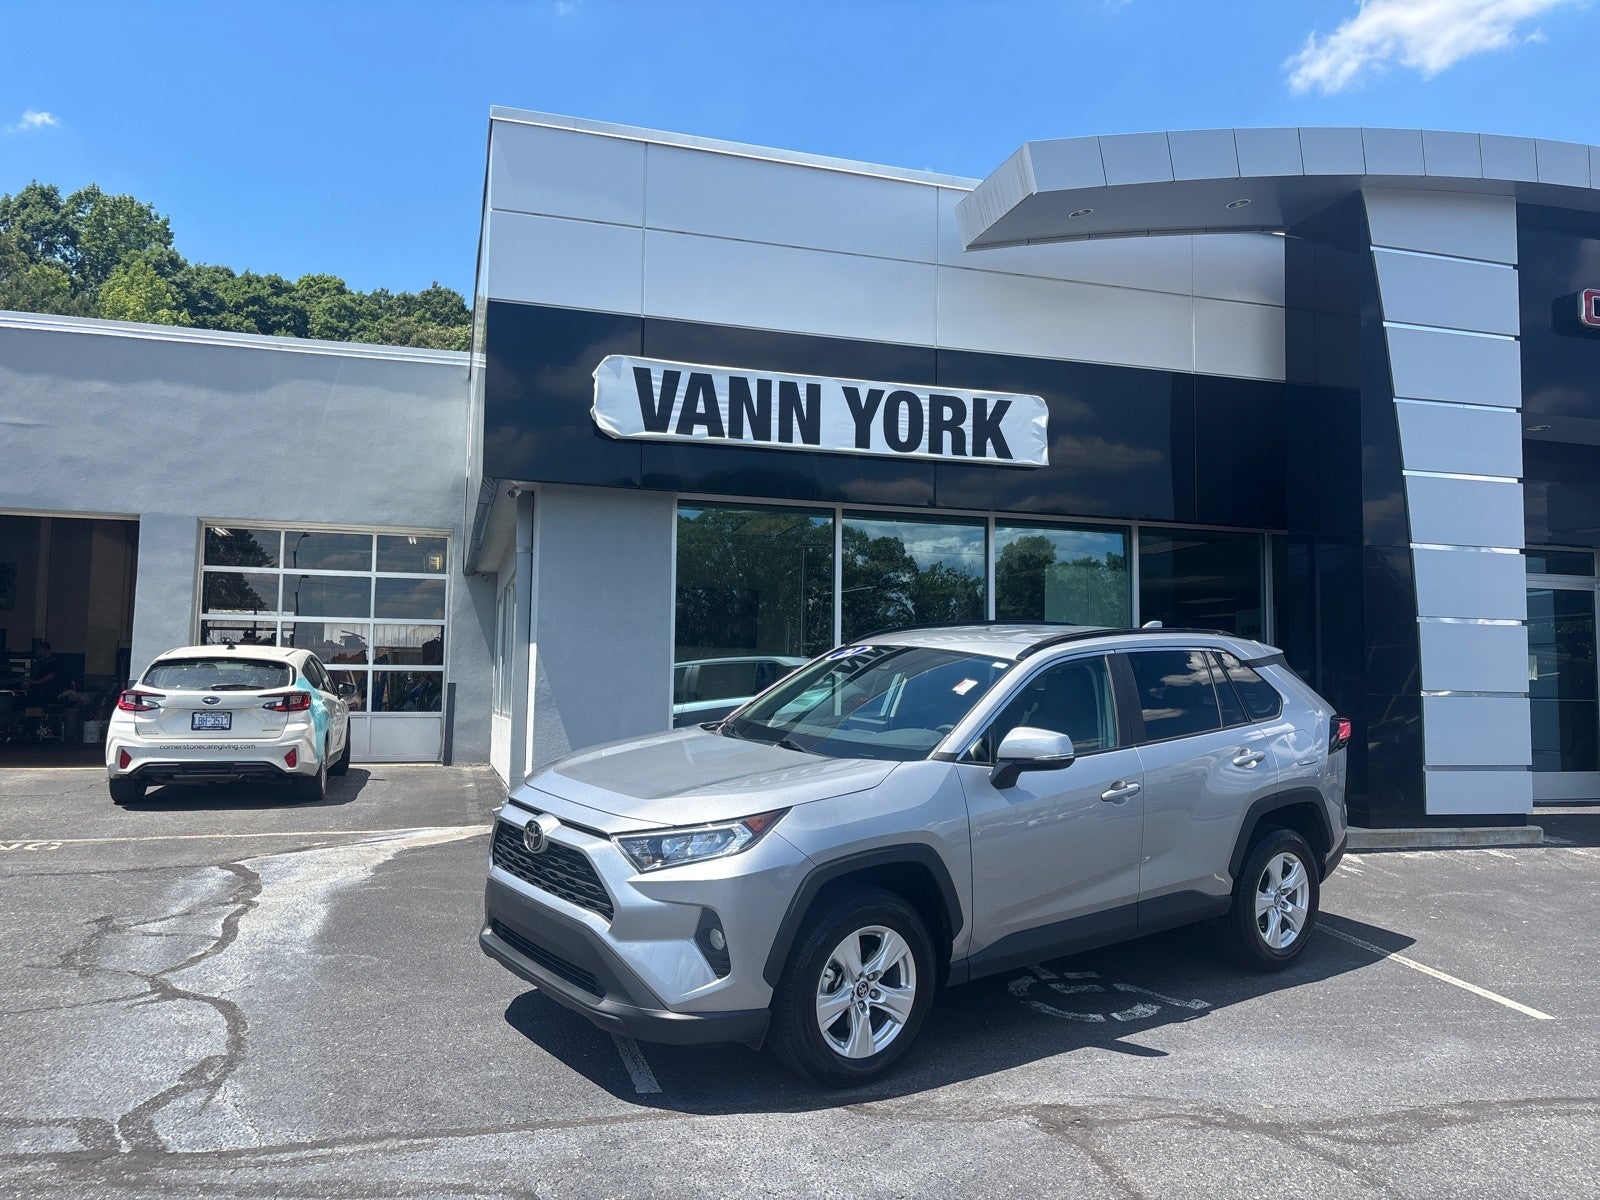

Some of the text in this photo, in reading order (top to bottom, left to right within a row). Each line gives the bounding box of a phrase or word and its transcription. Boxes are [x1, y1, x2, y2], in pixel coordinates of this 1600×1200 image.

[633, 367, 1014, 460] VANN YORK
[159, 743, 256, 751] cornerstonecaregiving.com
